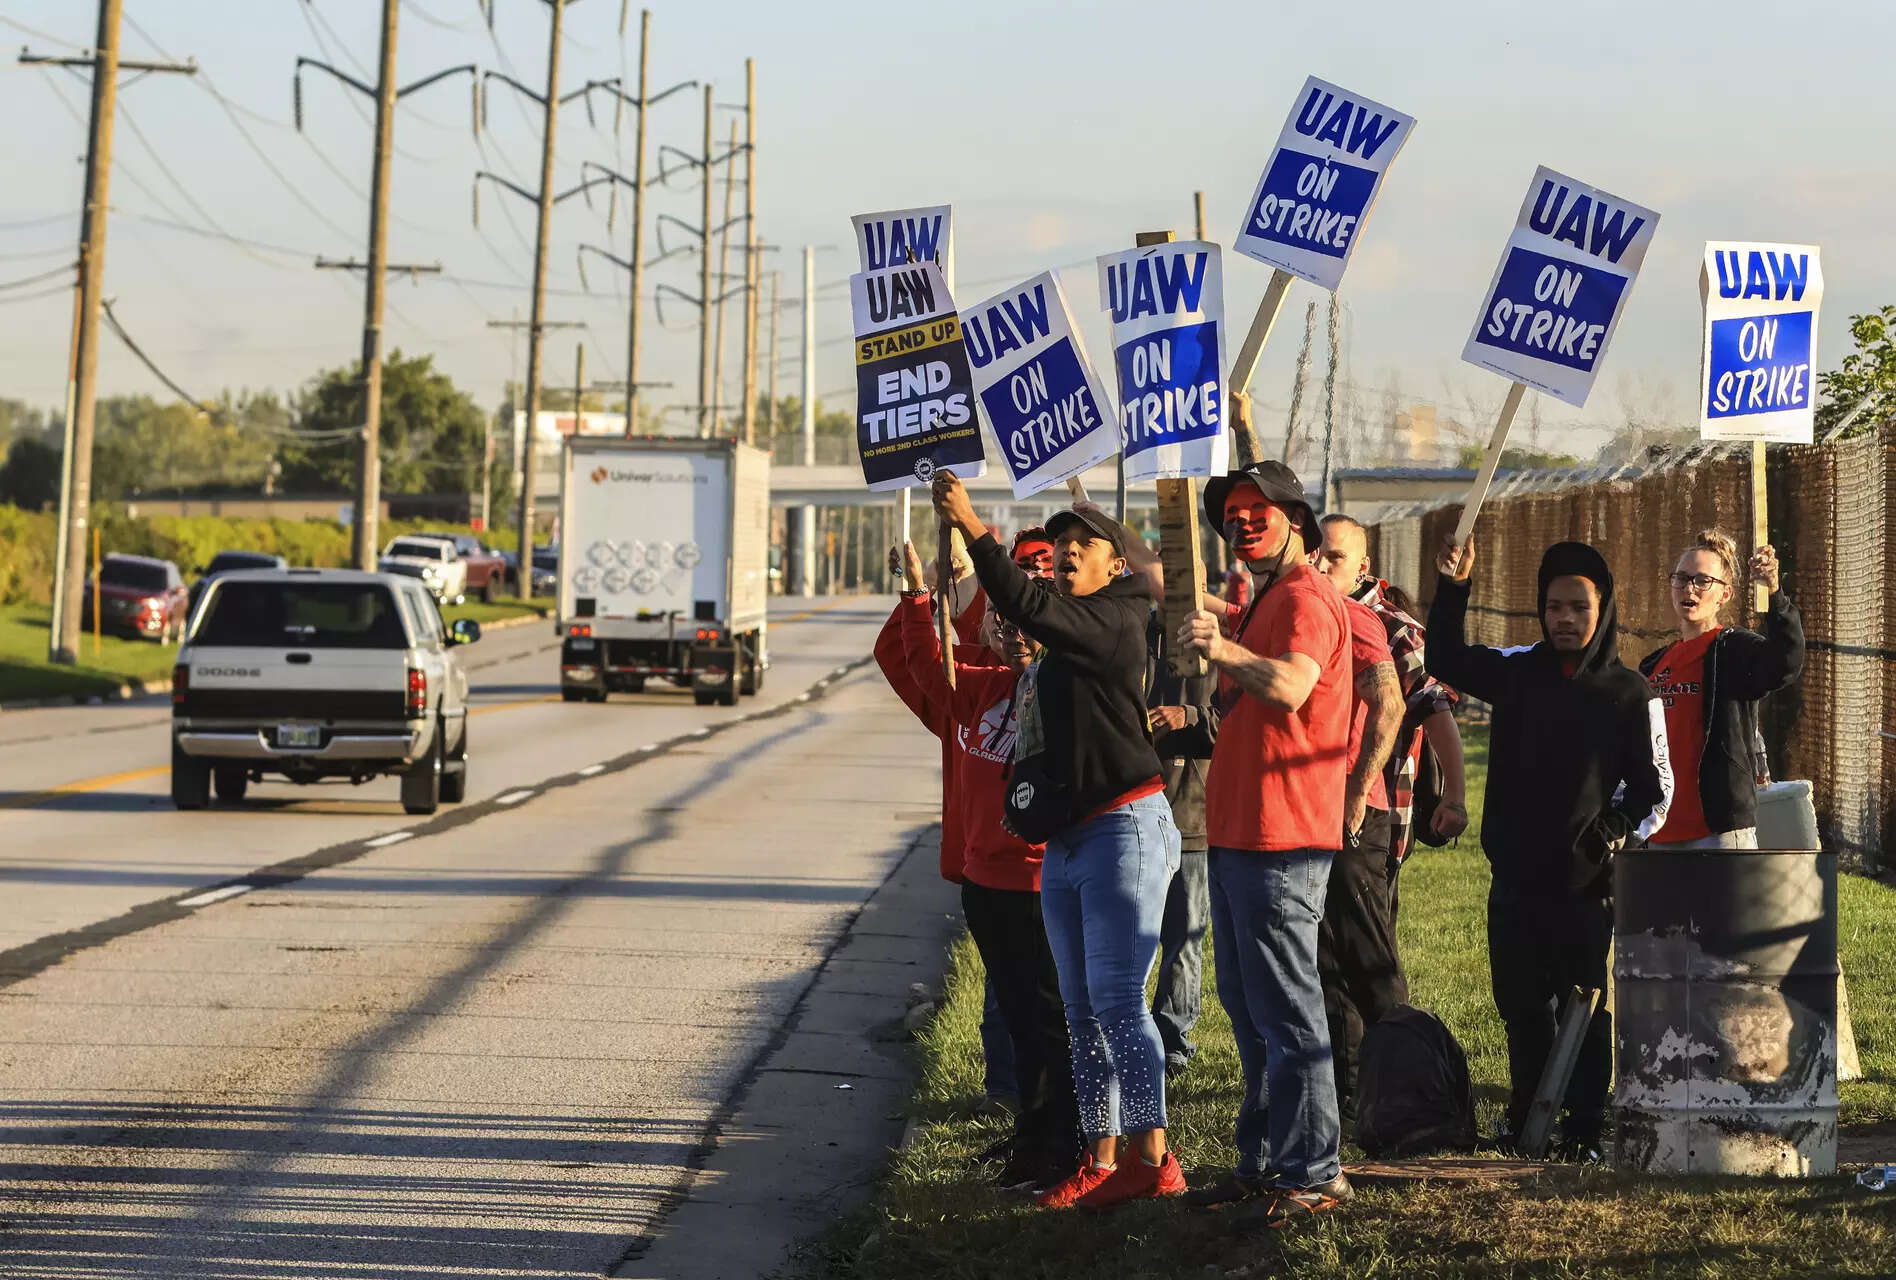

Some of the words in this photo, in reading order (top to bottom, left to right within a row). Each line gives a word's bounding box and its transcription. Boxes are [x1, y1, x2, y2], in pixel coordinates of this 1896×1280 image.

[1295, 88, 1400, 160] UAW
[1297, 162, 1339, 202] ON
[864, 215, 942, 271] UAW
[1256, 193, 1356, 248] STRIKE
[1529, 179, 1645, 264] UAW
[866, 268, 936, 323] UAW
[1107, 252, 1208, 324] UAW
[1534, 264, 1583, 308] ON
[1715, 250, 1808, 302] UAW
[861, 330, 926, 360] STAND
[931, 321, 956, 342] UP
[961, 283, 1050, 368] UAW
[1487, 298, 1605, 360] STRIKE
[1738, 318, 1778, 362] ON
[878, 361, 952, 405] END
[1011, 360, 1049, 414] ON
[1133, 338, 1171, 388] ON
[1712, 363, 1809, 412] STRIKE
[862, 393, 971, 444] TIERS
[1011, 386, 1095, 469] STRIKE
[1120, 381, 1219, 449] STRIKE
[863, 449, 875, 458] NO
[875, 444, 896, 455] MORE
[897, 442, 912, 451] 2ND
[912, 435, 938, 448] CLASS
[938, 428, 976, 440] WORKERS
